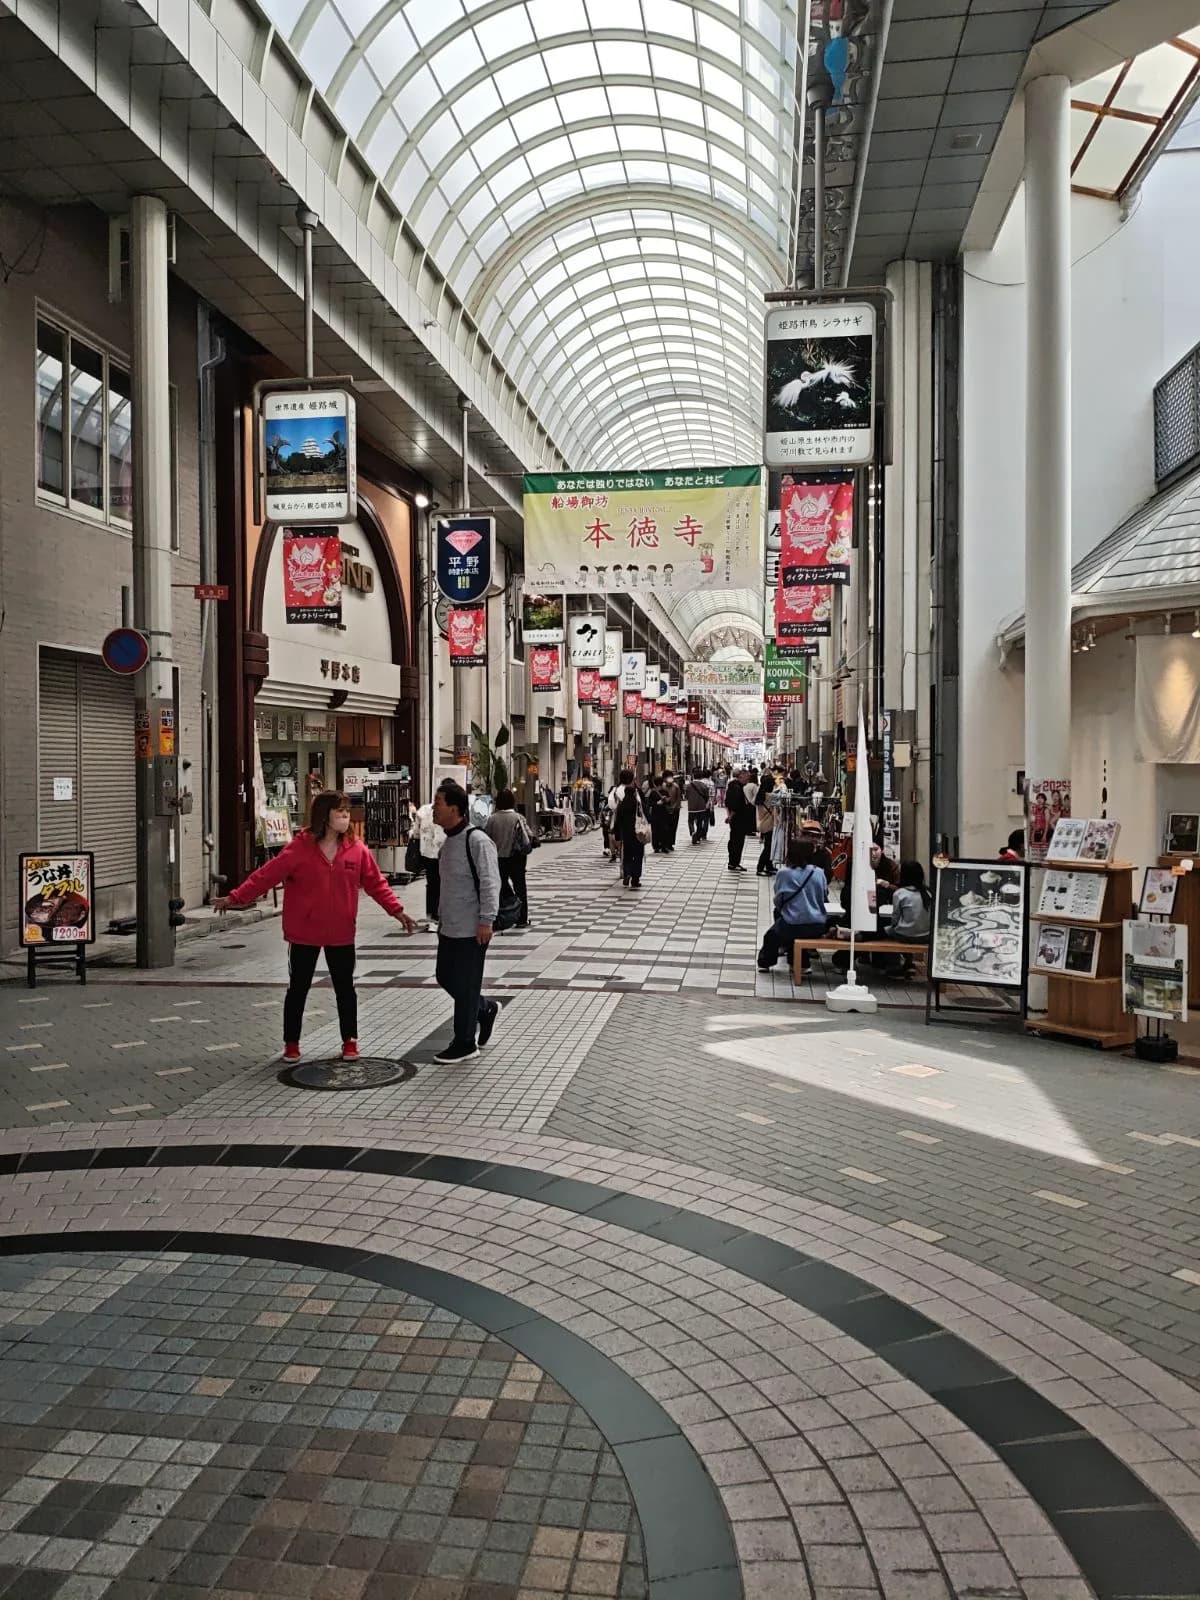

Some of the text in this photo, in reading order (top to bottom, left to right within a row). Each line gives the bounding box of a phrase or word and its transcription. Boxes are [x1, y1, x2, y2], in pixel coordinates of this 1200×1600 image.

[778, 316, 863, 330] 姫路市鳥 シラサギ
[275, 400, 338, 411] 世界遺産 姫路城
[556, 475, 724, 490] あなたは独りではない あなたと共に
[551, 495, 609, 509] 船場御坊
[583, 514, 704, 550] 本徳寺
[448, 556, 479, 567] 平野
[448, 567, 479, 575] 時計本店
[320, 659, 361, 684] 平野本店
[767, 668, 794, 678] KOOMA
[27, 863, 73, 886] うな丼
[40, 877, 85, 900] ダブル
[53, 927, 86, 940] 1200円
